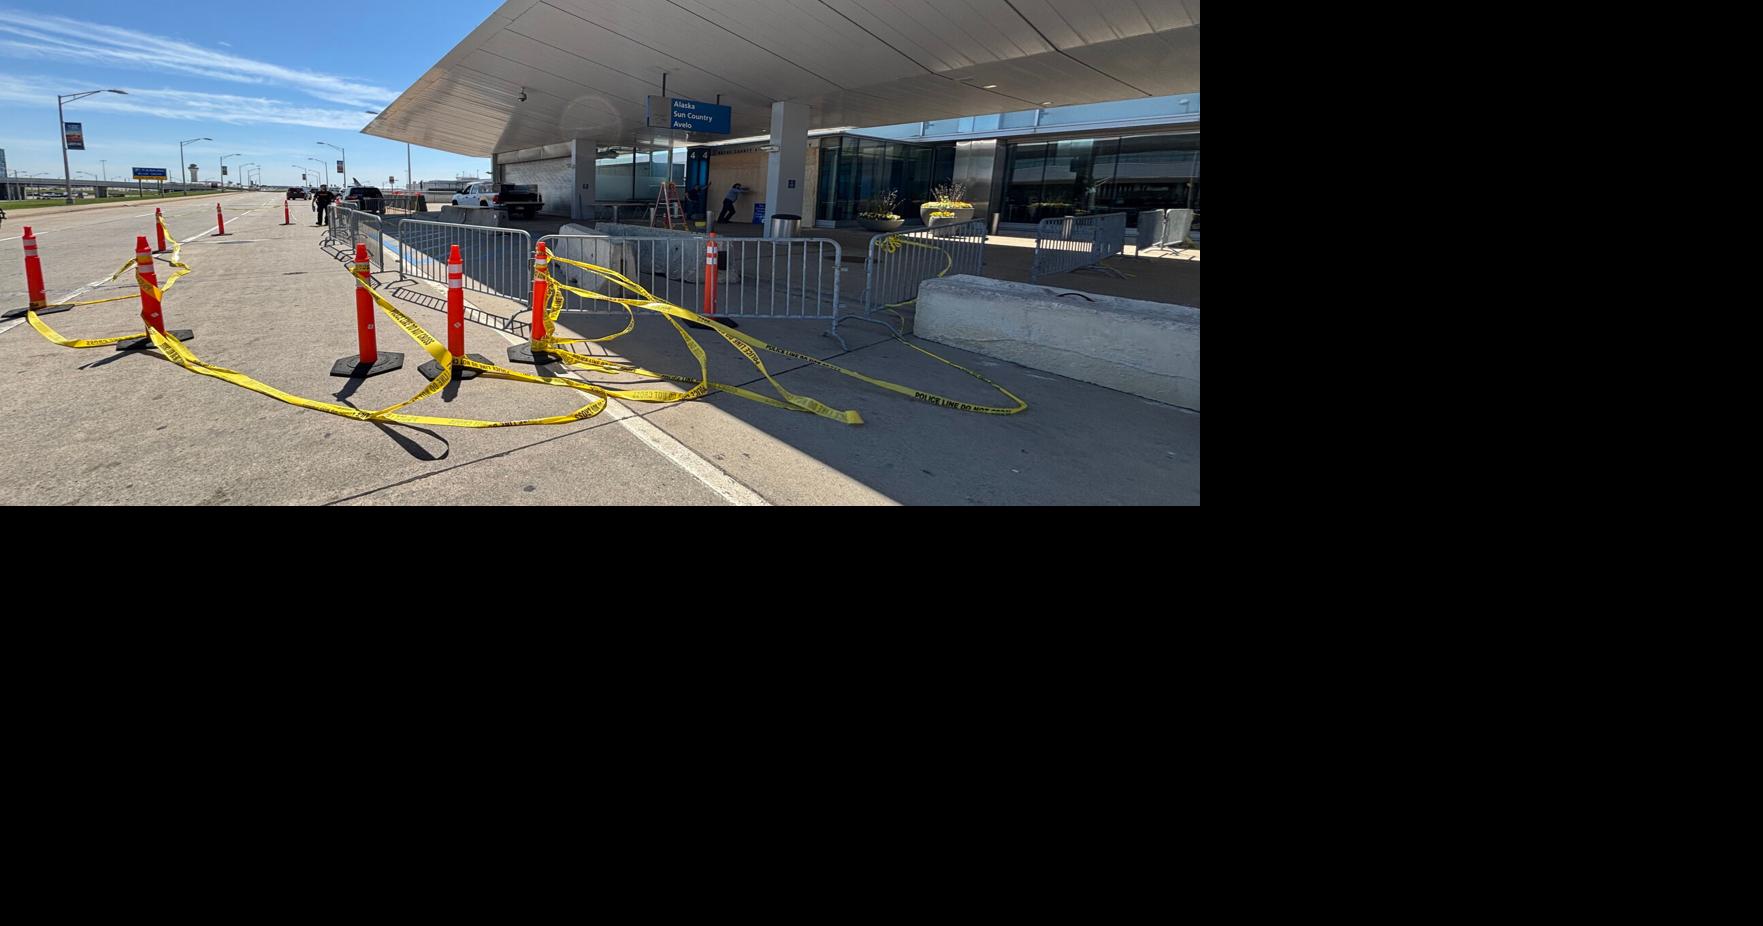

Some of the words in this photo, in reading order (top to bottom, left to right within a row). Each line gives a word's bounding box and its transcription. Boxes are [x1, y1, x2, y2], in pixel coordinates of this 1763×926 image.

[673, 101, 695, 110] Alaska
[673, 111, 686, 119] Sun
[687, 113, 712, 123] Country
[673, 121, 692, 129] Avelo
[690, 151, 696, 159] 4
[702, 151, 708, 159] 4
[732, 339, 748, 351] LINE
[745, 347, 761, 364] POLICE
[915, 391, 941, 406] POLICE
[941, 399, 959, 409] LINE
[960, 403, 972, 411] DO
